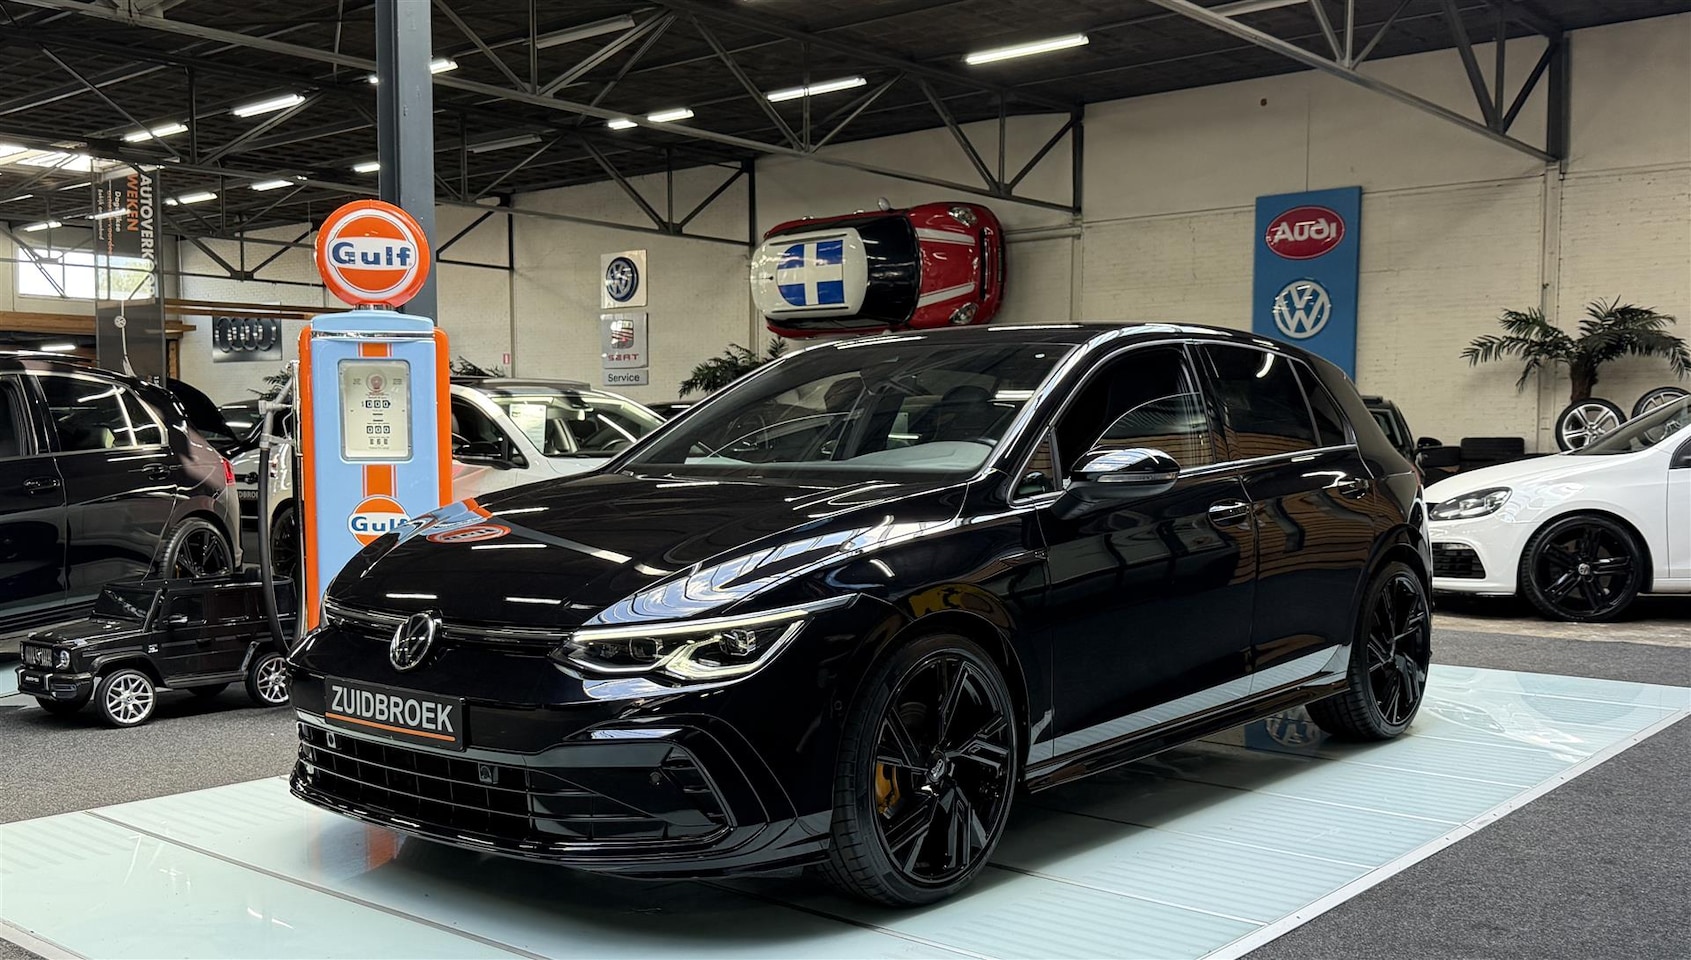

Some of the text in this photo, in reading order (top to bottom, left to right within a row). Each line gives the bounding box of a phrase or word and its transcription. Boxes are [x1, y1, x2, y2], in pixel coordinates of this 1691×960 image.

[126, 174, 140, 232] WEKEN
[332, 241, 411, 266] Gulf
[607, 353, 639, 362] SEAT
[608, 373, 640, 383] Service
[331, 685, 454, 733] ZUIDBROEK
